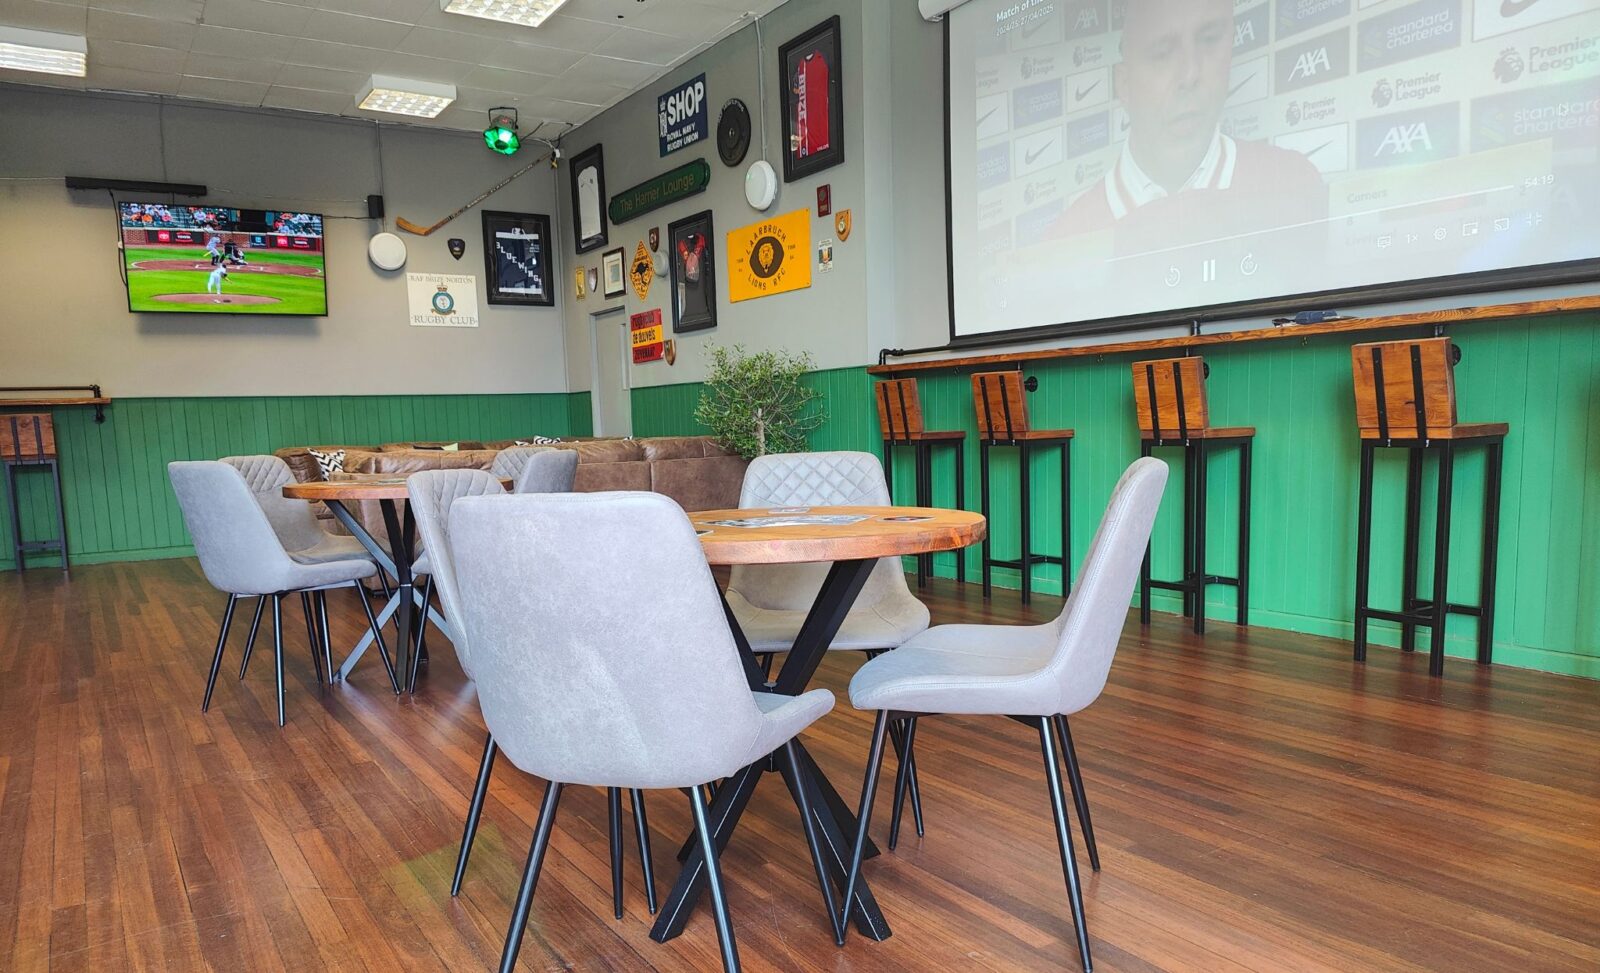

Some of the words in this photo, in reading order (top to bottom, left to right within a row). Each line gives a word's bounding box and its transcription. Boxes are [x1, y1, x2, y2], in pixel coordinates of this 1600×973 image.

[996, 4, 1020, 22] Match
[1073, 8, 1099, 31] AXA
[1388, 9, 1449, 38] standard
[1387, 21, 1453, 48] chartered
[1288, 46, 1331, 82] AXA
[1528, 50, 1600, 74] League
[1395, 72, 1441, 89] Premier
[1395, 84, 1441, 101] League
[667, 81, 704, 126] SHOP
[799, 74, 807, 118] BRIZE
[667, 130, 682, 142] ROYAL
[682, 122, 695, 134] NAVY
[667, 139, 683, 152] RUGBY
[684, 132, 699, 145] UNION
[1374, 122, 1432, 157] AXA
[621, 199, 633, 213] The
[635, 187, 660, 208] Harrier
[663, 173, 694, 195] Lounge
[746, 225, 787, 255] LAARBRUCH
[747, 273, 767, 291] LIONS
[772, 267, 786, 287] RFC
[413, 315, 447, 325] RUGBY
[449, 316, 476, 326] CLUB
